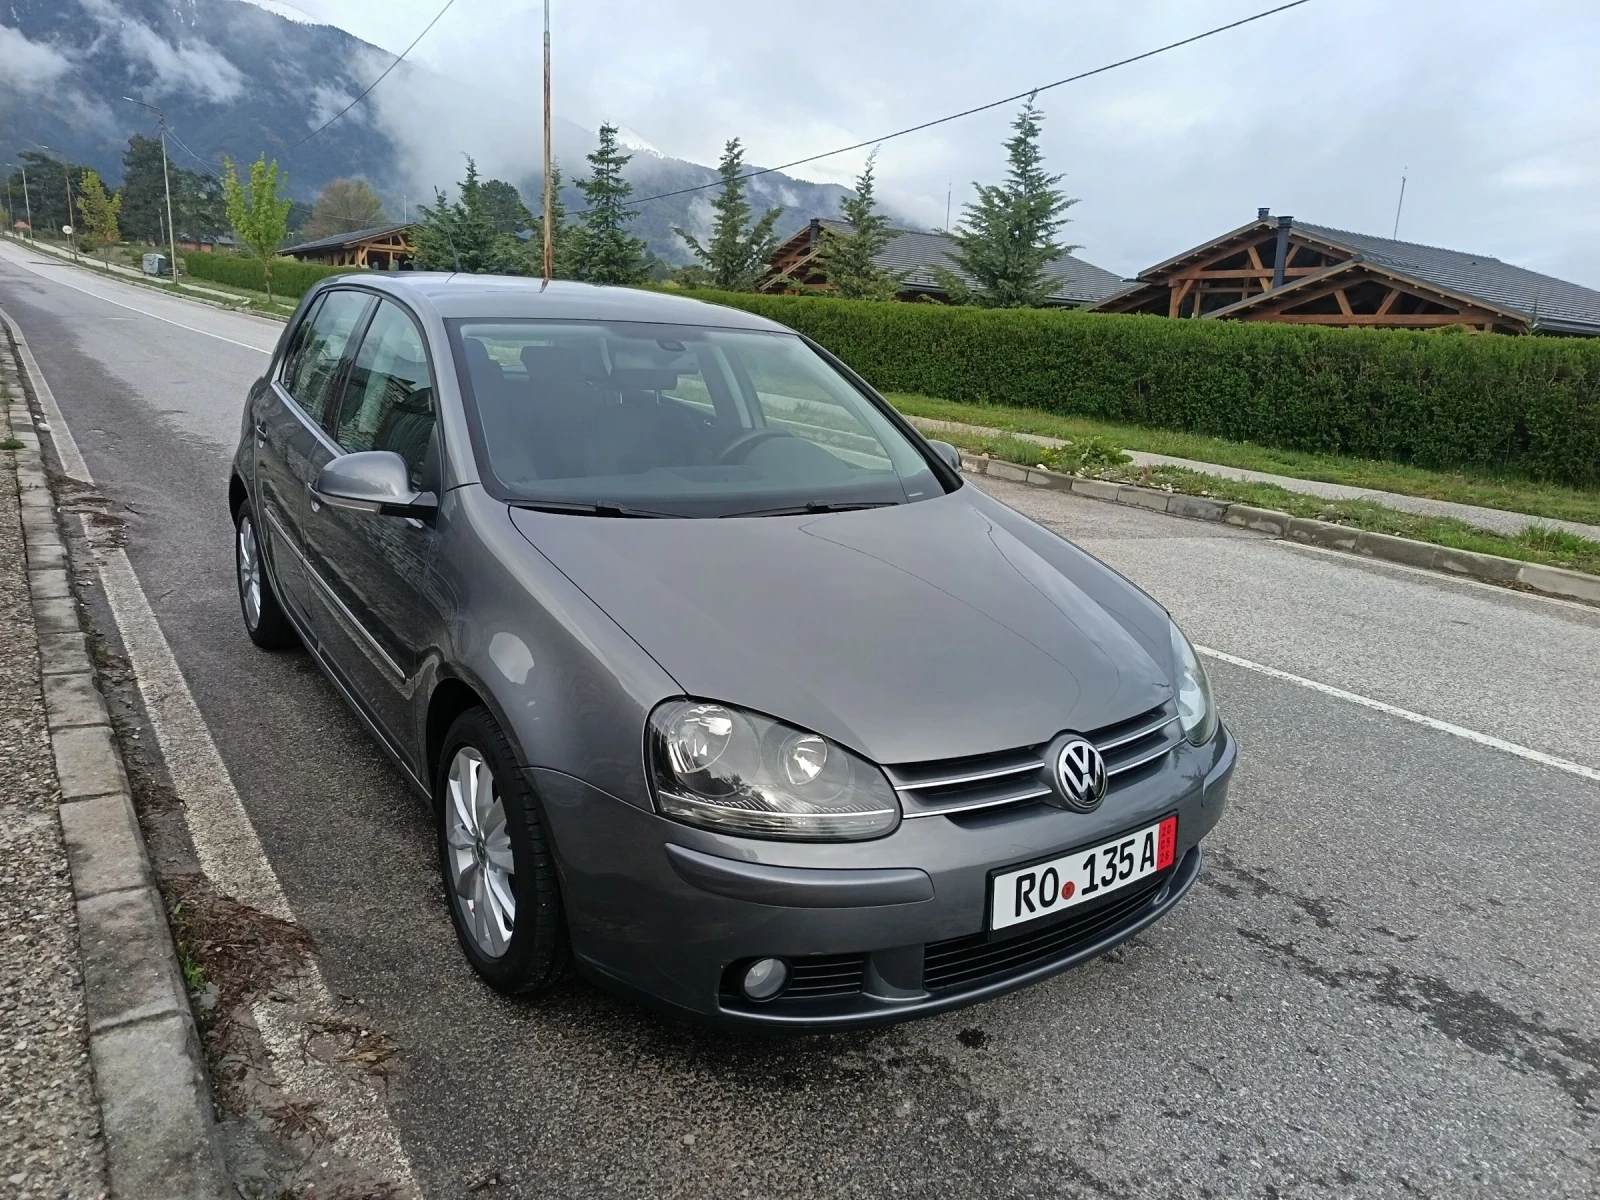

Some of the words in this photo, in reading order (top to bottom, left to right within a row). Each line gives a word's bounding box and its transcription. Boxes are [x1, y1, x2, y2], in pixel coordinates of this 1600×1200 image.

[1058, 741, 1106, 805] VW
[1160, 837, 1171, 850] 05
[1161, 824, 1171, 837] 20
[1015, 867, 1059, 917] RO
[1081, 839, 1136, 895] 135
[1140, 832, 1155, 872] A
